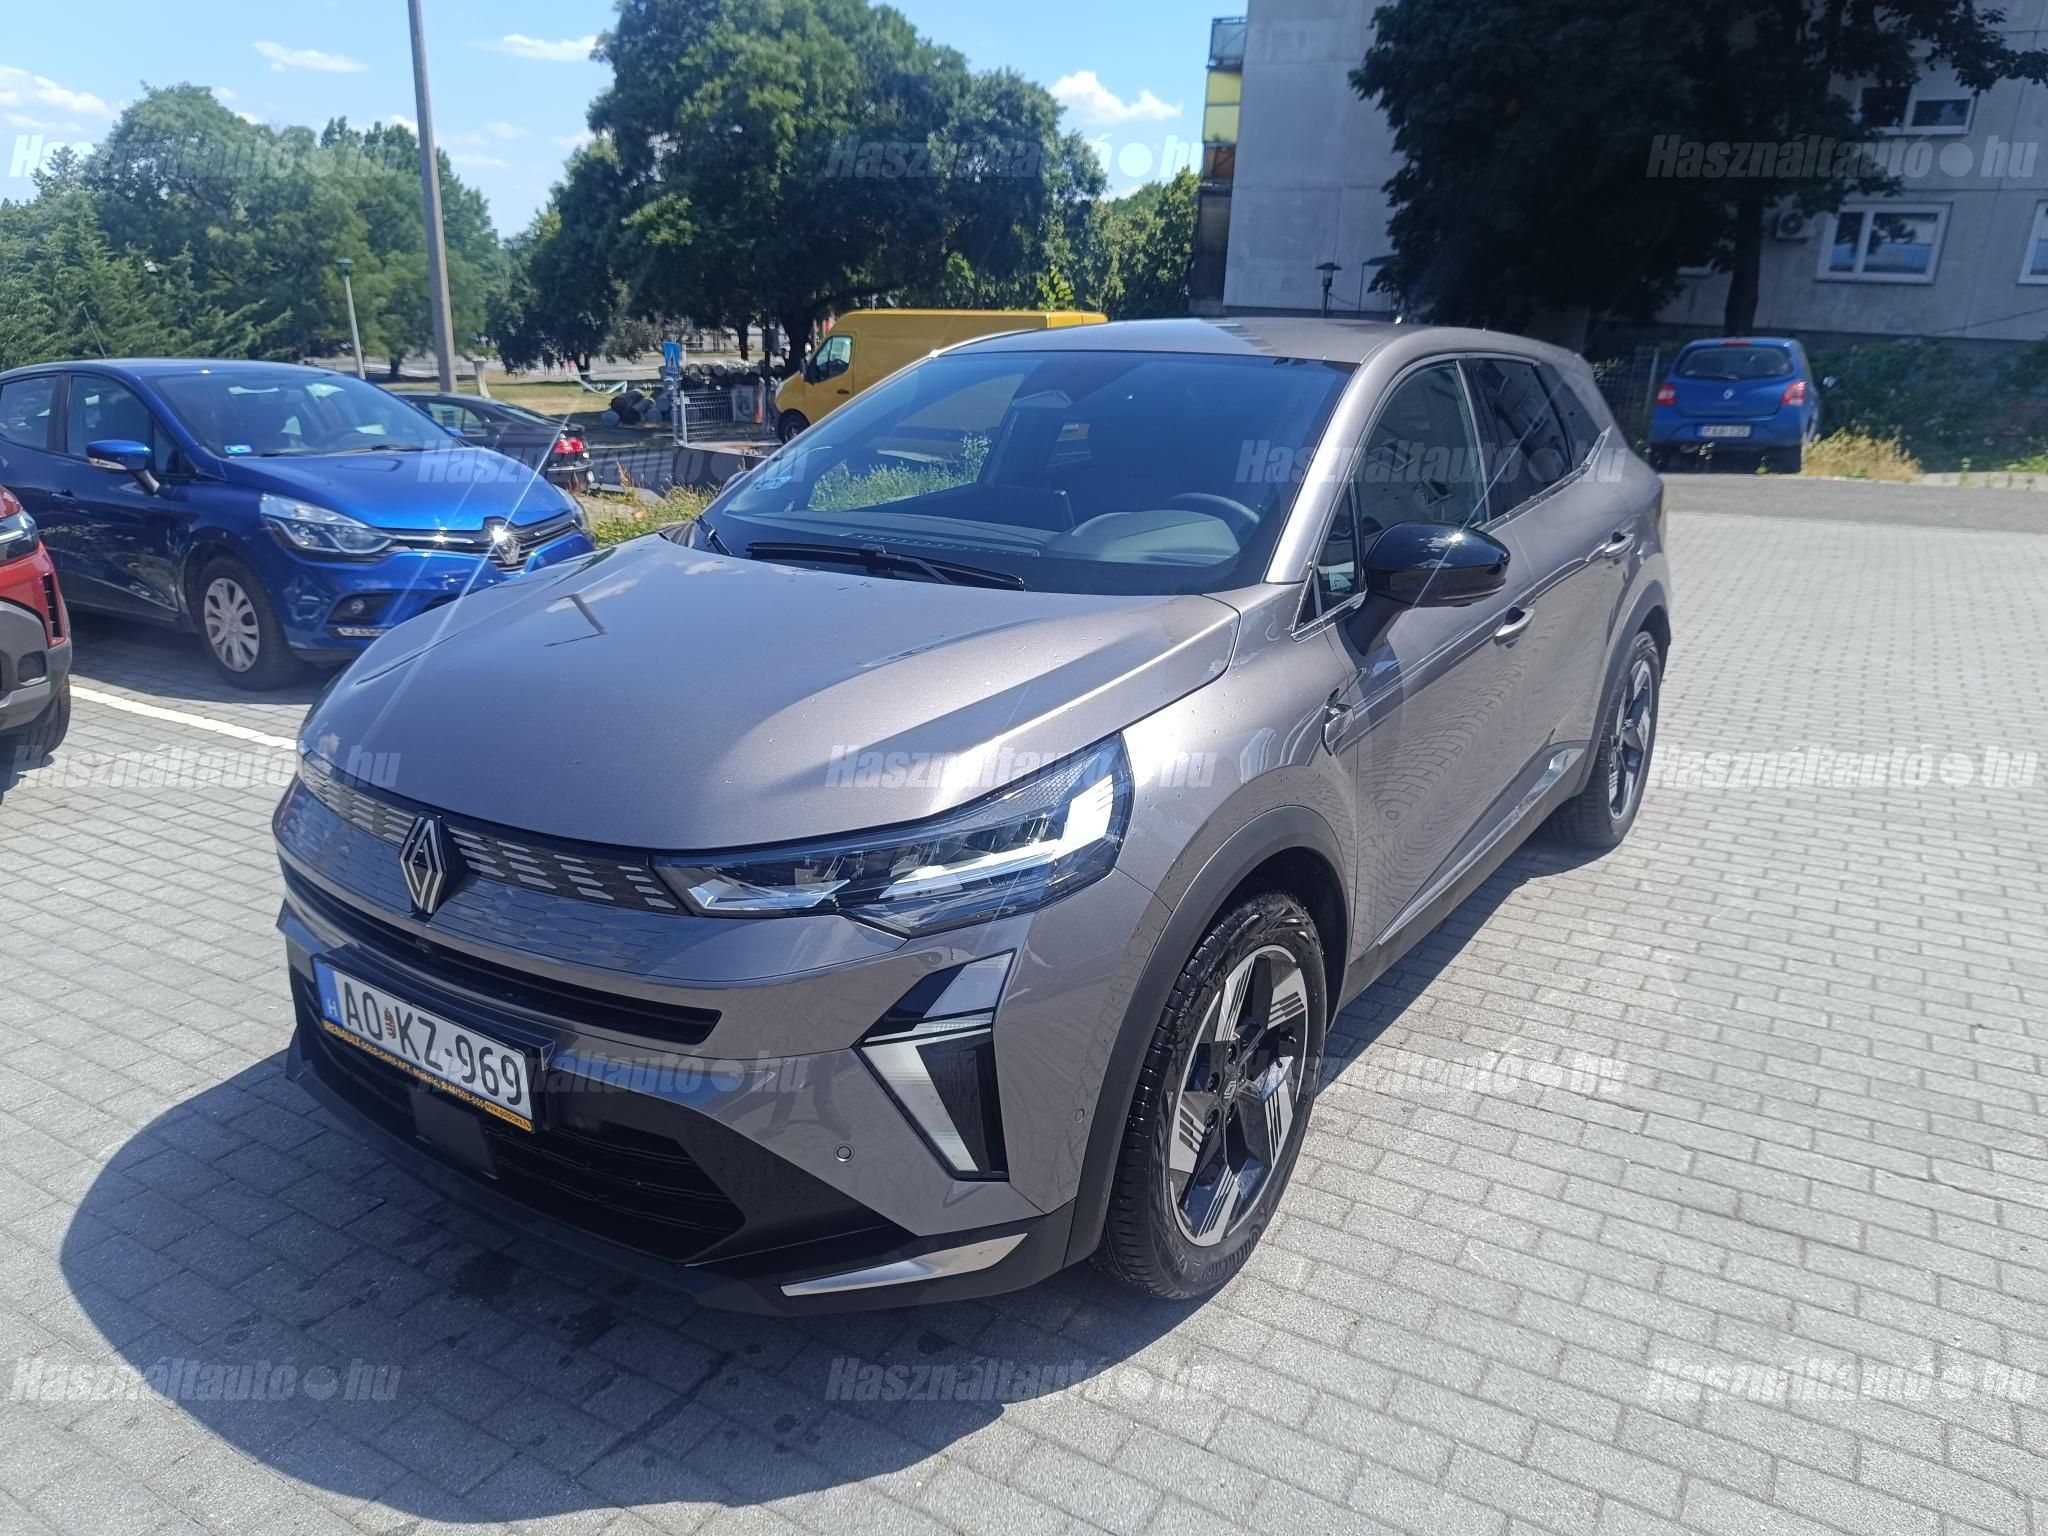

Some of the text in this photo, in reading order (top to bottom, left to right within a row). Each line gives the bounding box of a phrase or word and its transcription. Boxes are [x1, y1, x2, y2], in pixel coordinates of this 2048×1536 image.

[327, 999, 338, 1017] H
[323, 1020, 361, 1047] RENAULT
[344, 981, 523, 1107] AO KZ-969
